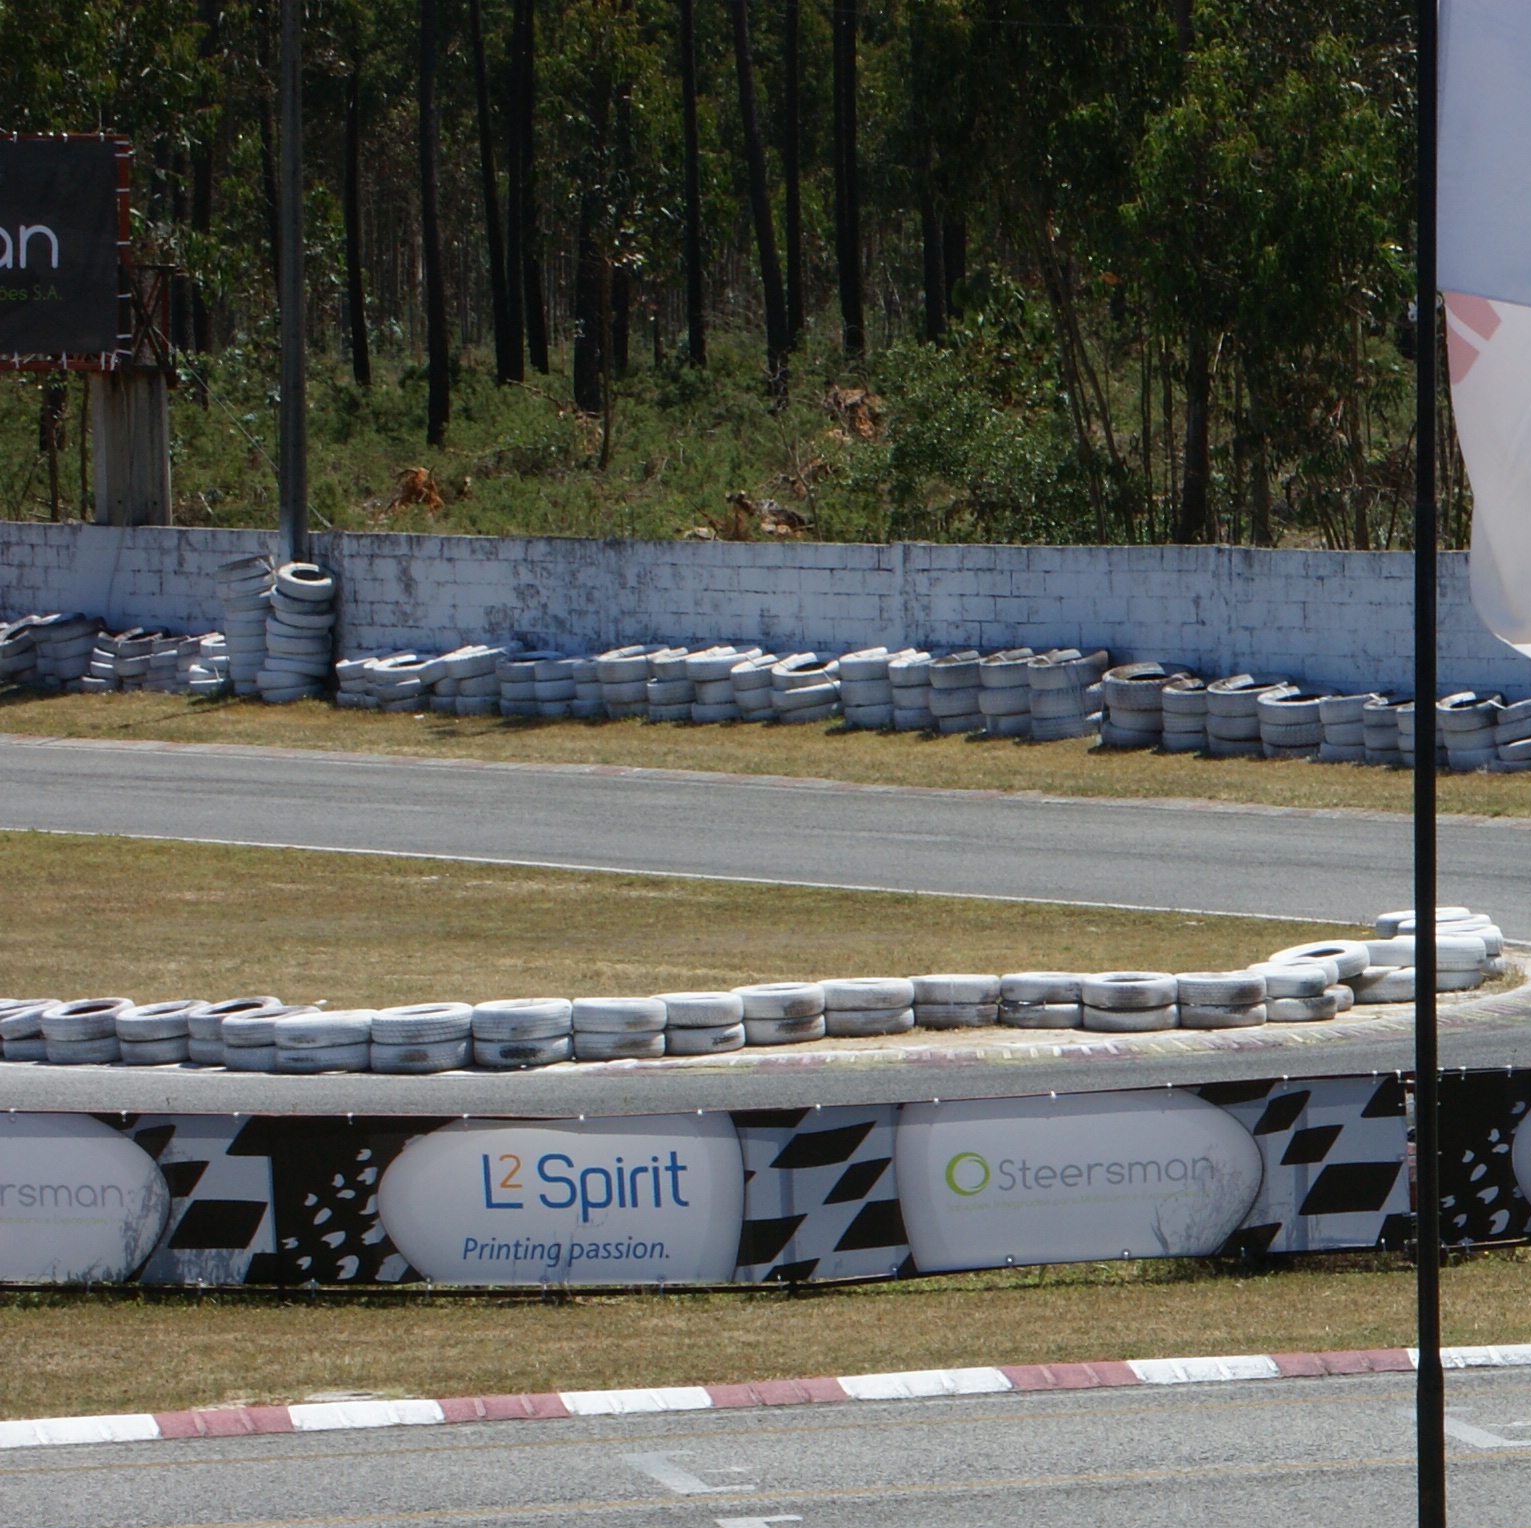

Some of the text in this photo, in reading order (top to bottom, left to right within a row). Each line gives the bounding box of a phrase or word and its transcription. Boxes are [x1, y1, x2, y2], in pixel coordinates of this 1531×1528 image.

[536, 1150, 690, 1223] Spirit
[997, 1155, 1216, 1192] Steersman
[0, 1183, 124, 1208] rsman
[462, 1235, 671, 1268] Printing passion.
